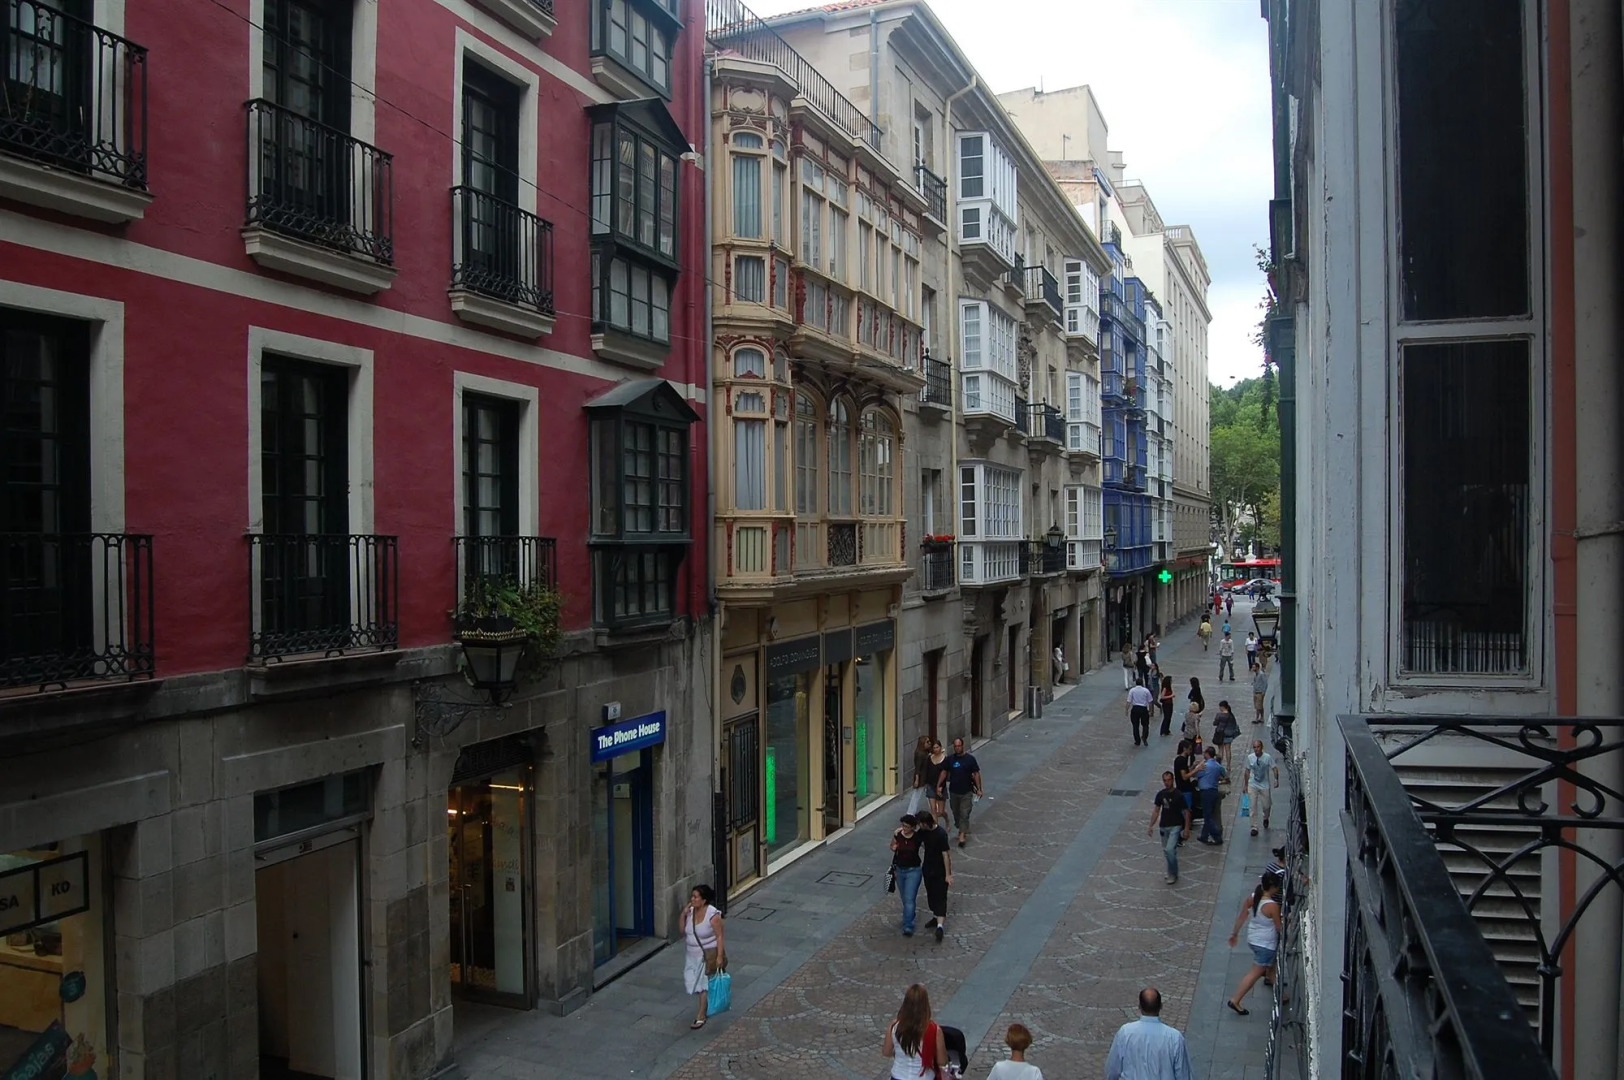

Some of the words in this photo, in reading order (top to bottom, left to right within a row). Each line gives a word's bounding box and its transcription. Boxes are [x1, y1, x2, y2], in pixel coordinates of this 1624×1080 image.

[597, 734, 613, 750] The
[613, 728, 638, 745] Phone
[638, 721, 660, 738] House
[51, 881, 71, 896] KO
